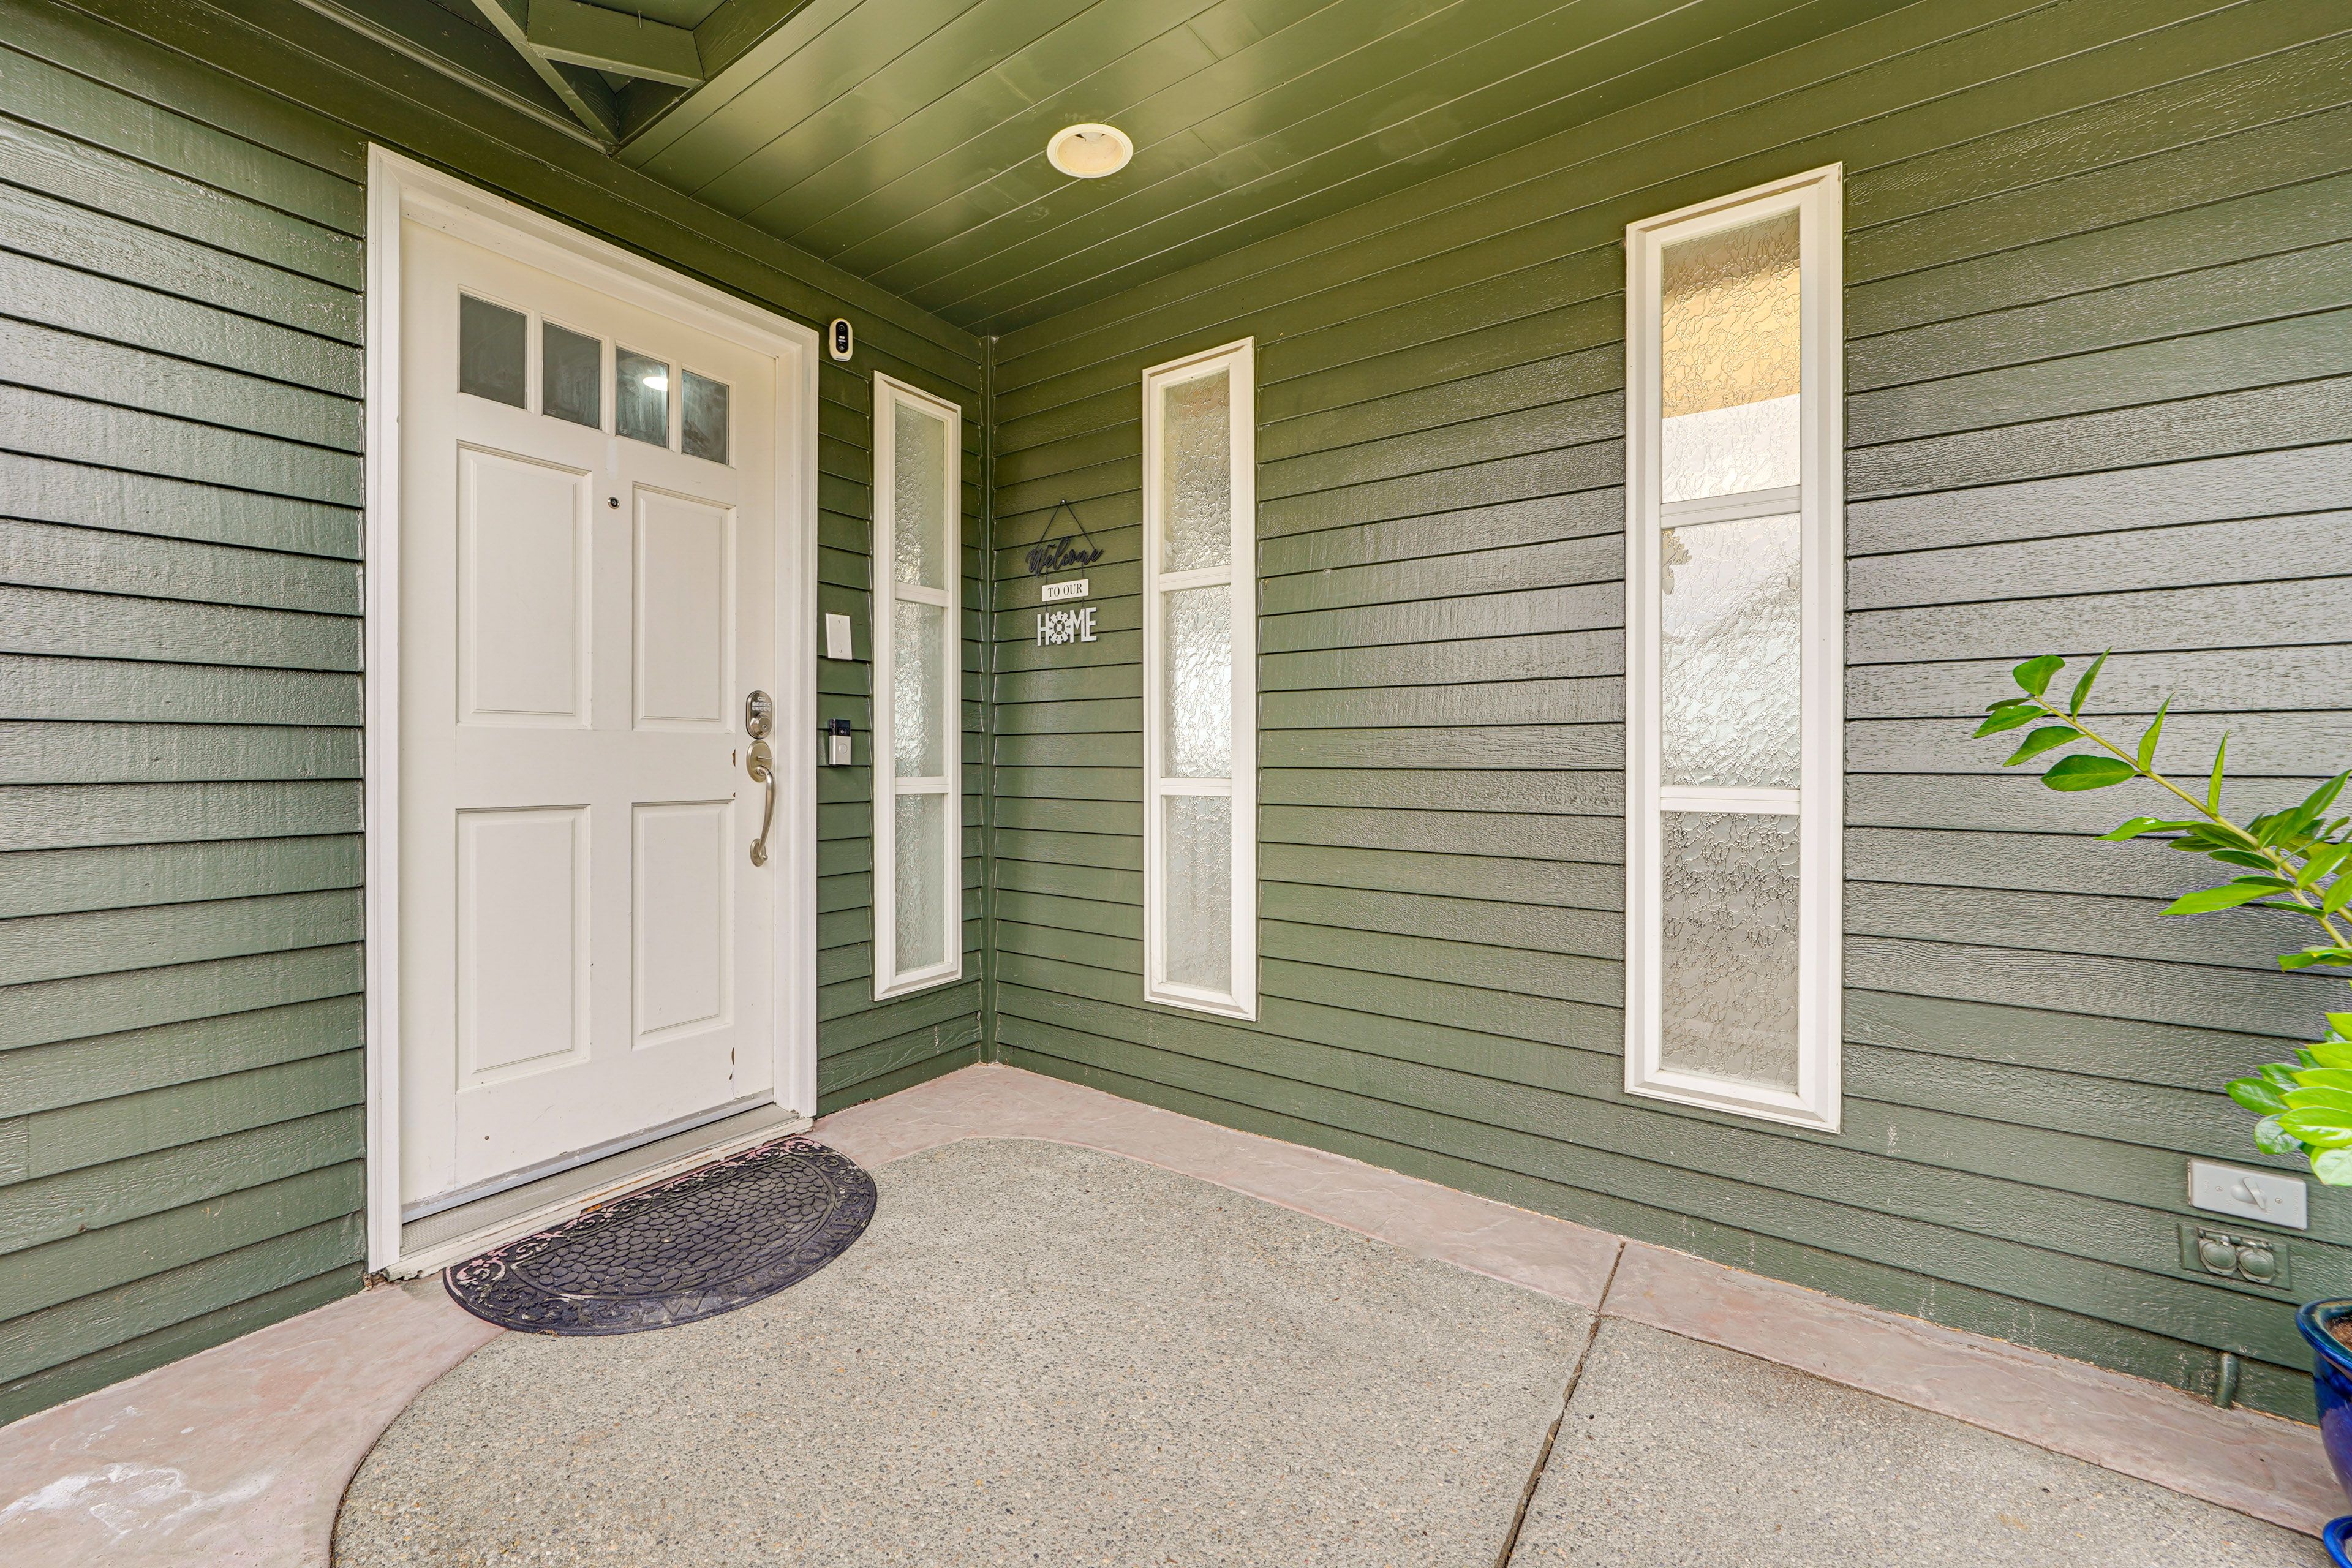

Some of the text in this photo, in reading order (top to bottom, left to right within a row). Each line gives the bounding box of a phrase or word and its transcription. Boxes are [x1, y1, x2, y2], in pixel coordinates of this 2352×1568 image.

[1025, 536, 1104, 576] Welcome
[1047, 583, 1082, 598] TO OUR
[1037, 607, 1097, 646] HOME
[658, 1217, 861, 1316] WELCOME
